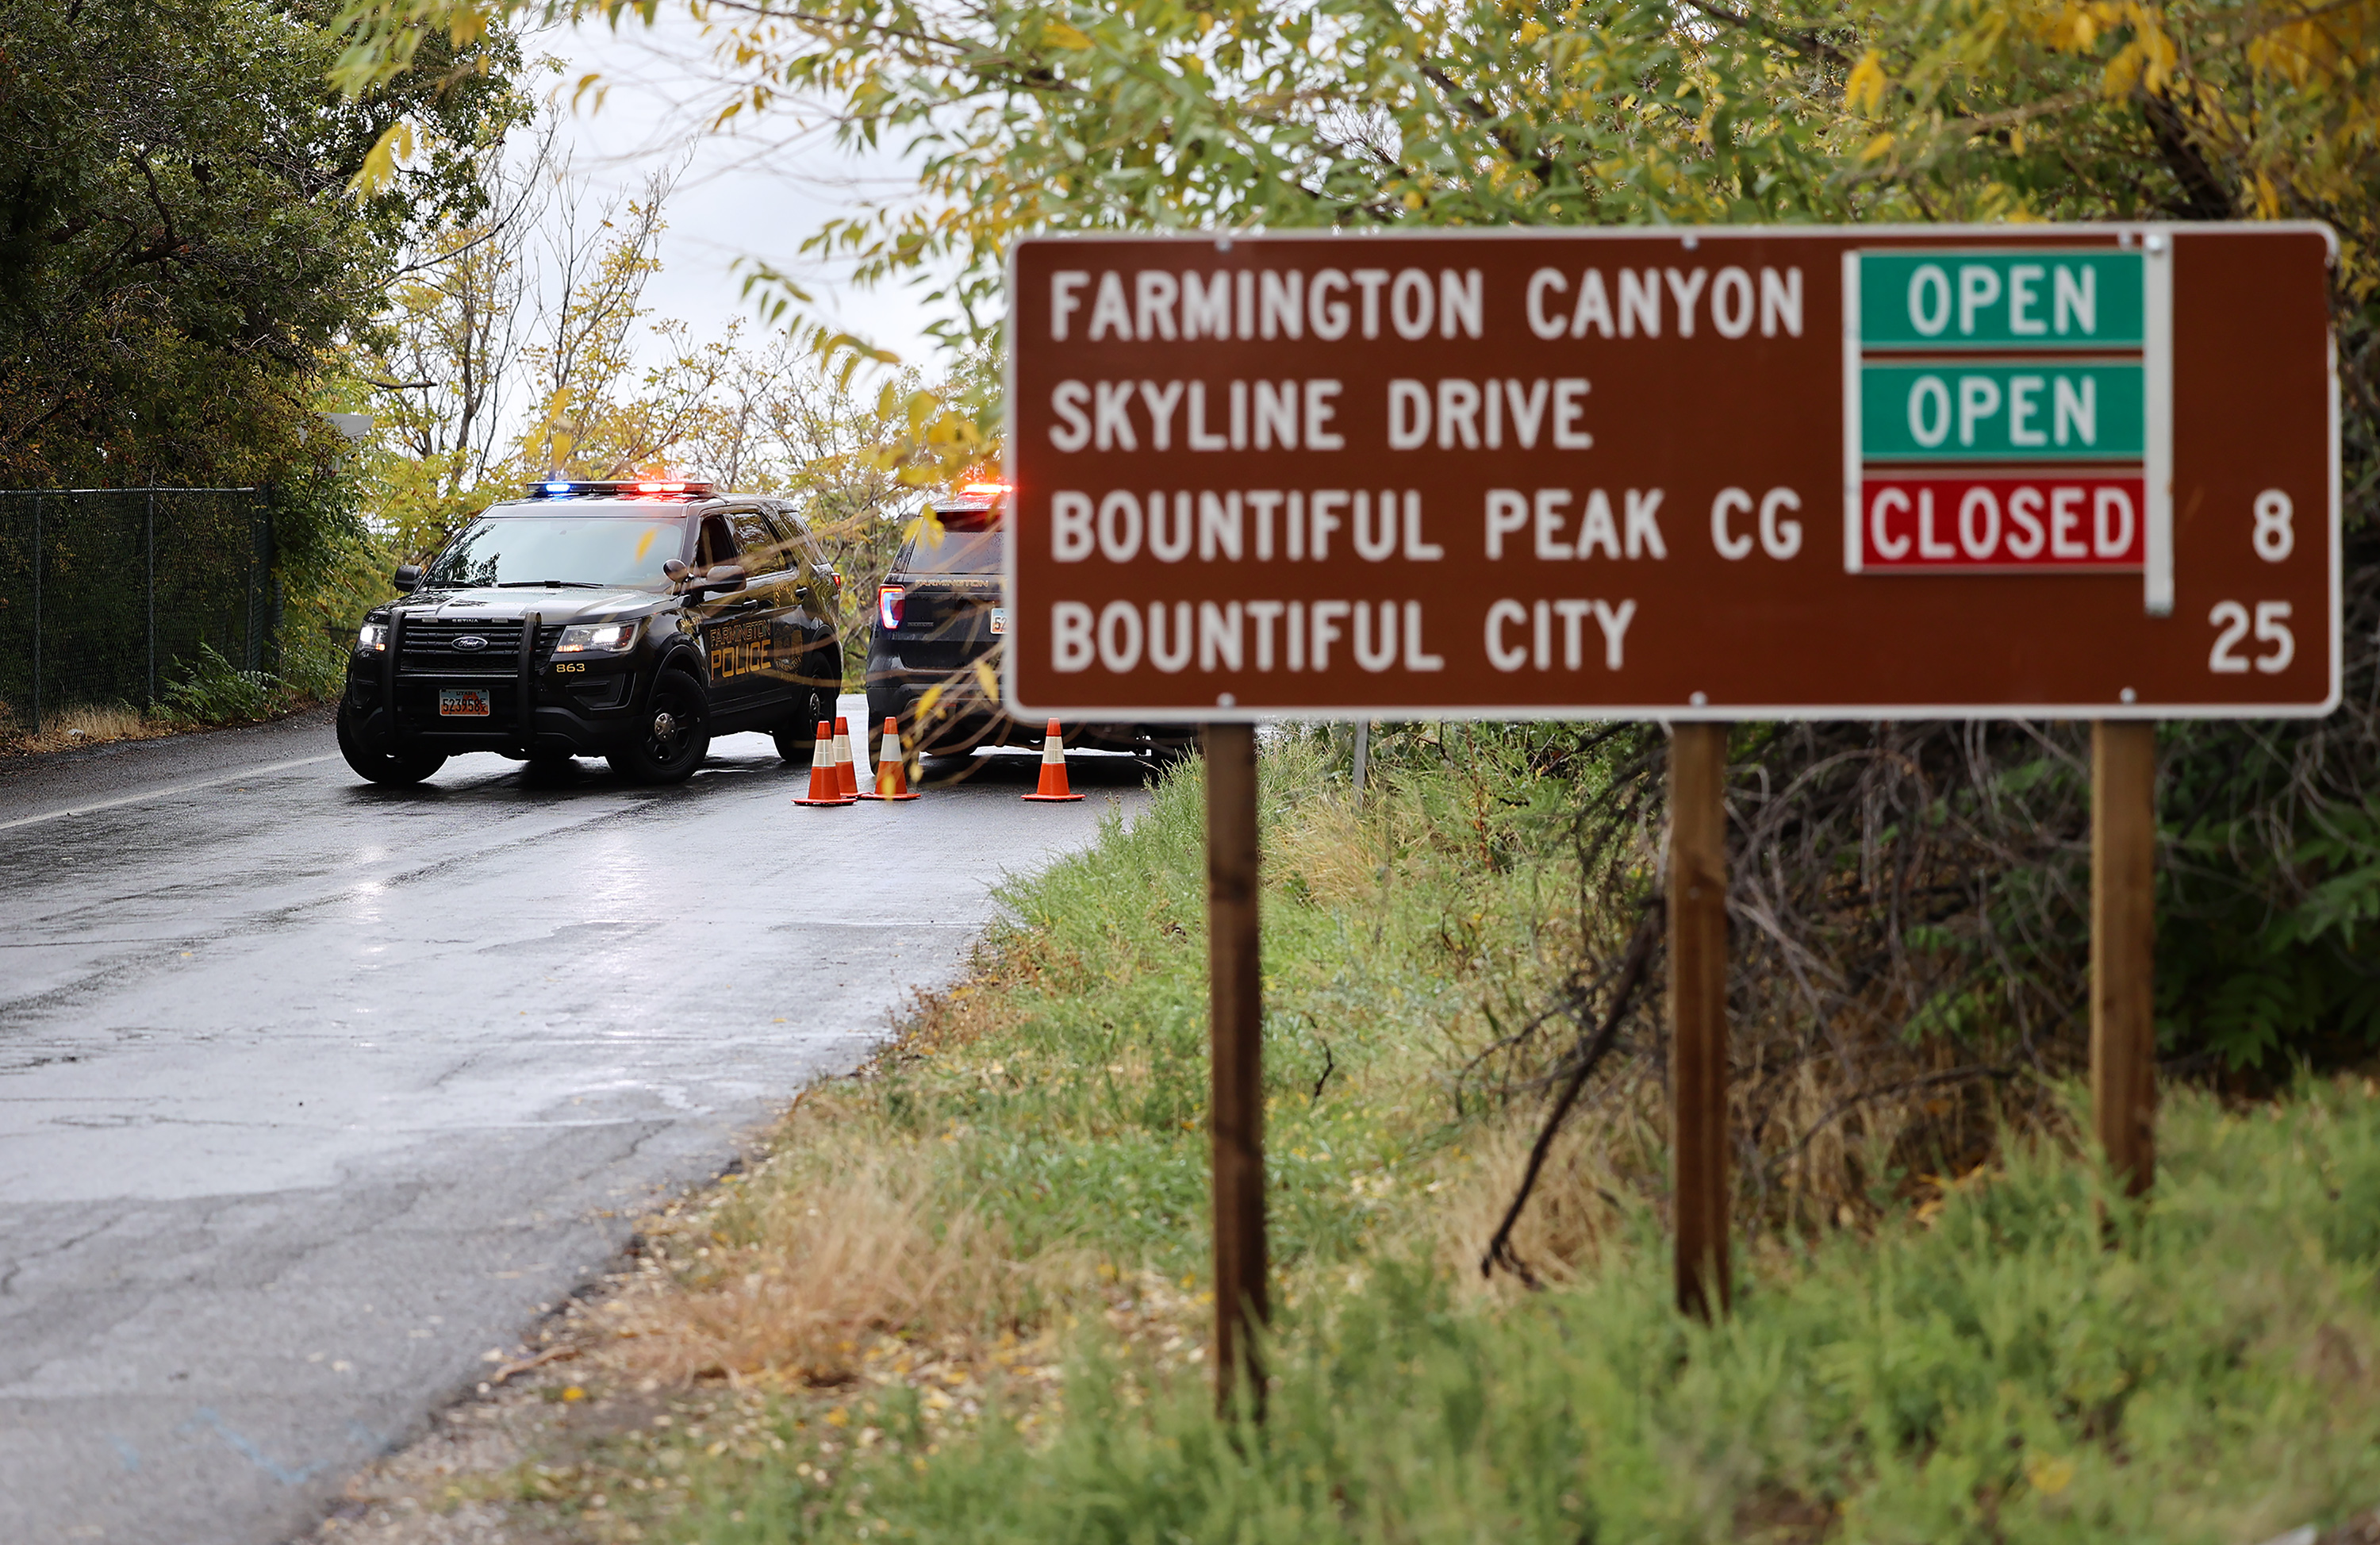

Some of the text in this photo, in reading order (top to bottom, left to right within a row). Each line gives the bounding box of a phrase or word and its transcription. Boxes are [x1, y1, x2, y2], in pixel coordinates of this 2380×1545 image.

[1053, 268, 1801, 339] FARMINGTON CANYON
[1910, 267, 2094, 333] OPEN
[1052, 379, 1590, 450] SKYLINE DRIVE
[1910, 378, 2094, 444] OPEN
[1053, 489, 2293, 561] BOUNTIFUL PEAK CG 8
[1872, 489, 2134, 558] CLOSED
[710, 620, 771, 647] FARMINGTON
[711, 639, 772, 681] POLICE
[1053, 600, 2294, 671] BOUNTIFUL CITY 25
[556, 663, 585, 672] 863
[443, 698, 480, 712] 523958
